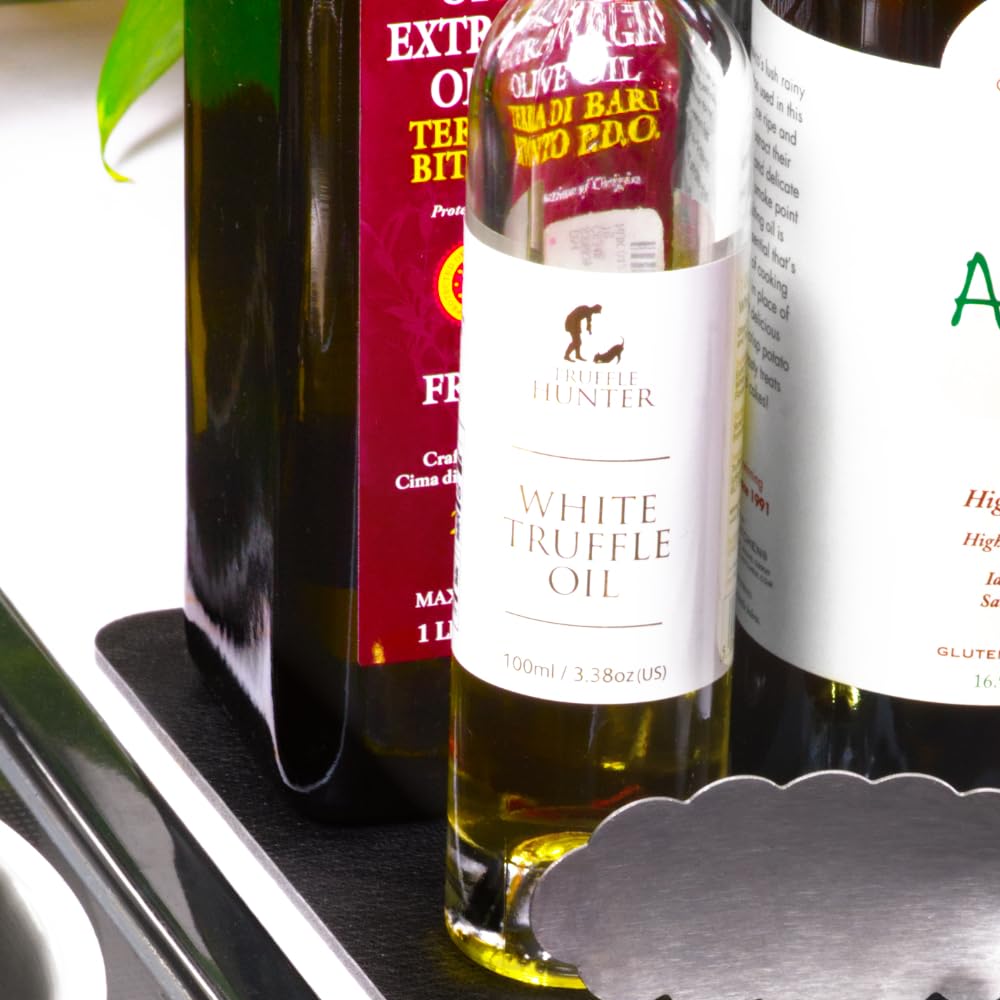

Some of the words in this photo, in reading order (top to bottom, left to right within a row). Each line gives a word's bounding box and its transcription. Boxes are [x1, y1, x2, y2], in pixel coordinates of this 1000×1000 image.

[511, 62, 567, 99] OLIVE
[782, 77, 806, 102] rainy
[550, 97, 576, 126] DI
[583, 88, 660, 120] BARI
[777, 95, 784, 113] in
[787, 100, 803, 123] this
[779, 128, 797, 146] and
[772, 143, 791, 169] their
[766, 165, 800, 199] delicate
[775, 203, 799, 225] point
[757, 269, 788, 300] cooking
[757, 287, 777, 315] place
[779, 304, 790, 321] of
[762, 346, 790, 373] potato
[555, 367, 640, 386] TRUFFLE
[533, 380, 655, 409] HUNTER
[395, 474, 439, 490] Cima
[519, 484, 657, 525] WHITE
[503, 516, 671, 562] TRUFFLE
[548, 566, 620, 598] OIL
[418, 623, 429, 643] 1
[503, 653, 555, 679] 100ml
